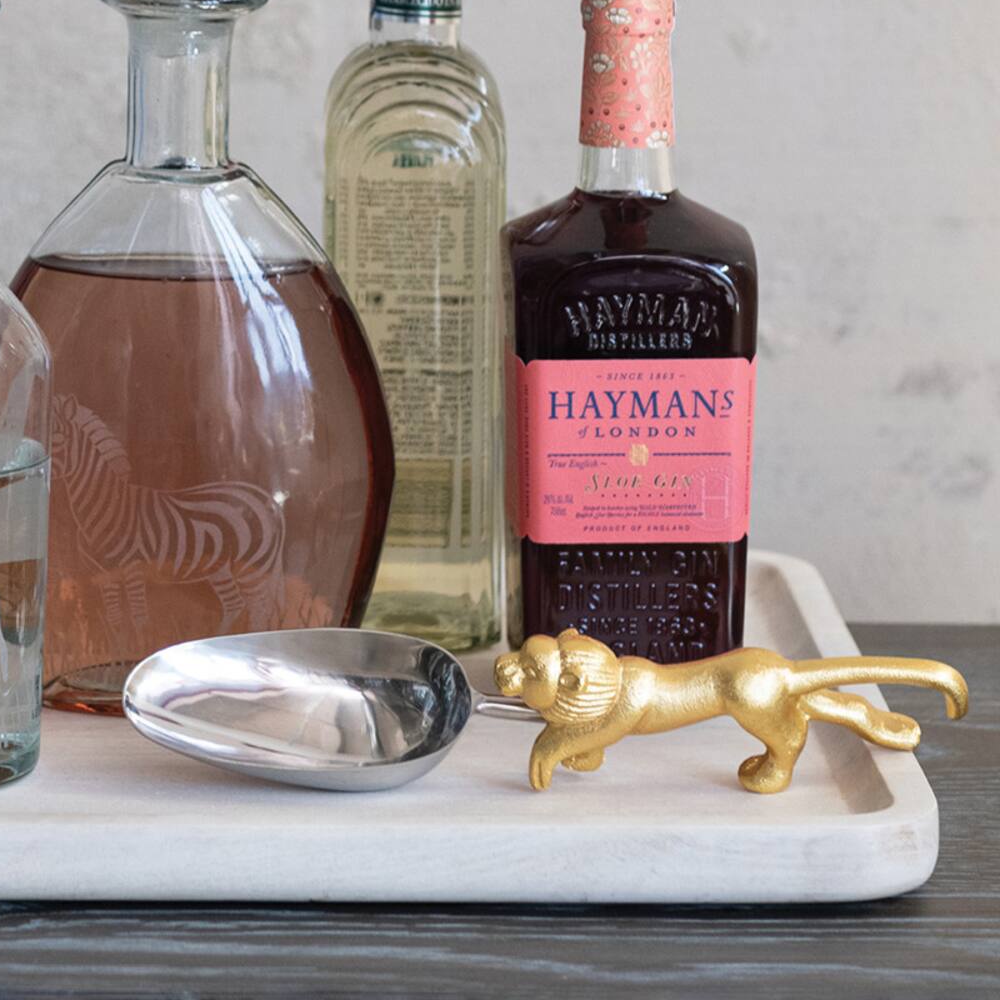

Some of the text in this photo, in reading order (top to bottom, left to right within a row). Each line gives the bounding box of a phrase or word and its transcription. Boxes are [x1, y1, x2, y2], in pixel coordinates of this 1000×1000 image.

[564, 292, 720, 338] HAYMAN
[588, 331, 693, 350] DISTILLERS
[606, 372, 643, 381] SINCE
[594, 426, 697, 438] LONDON
[549, 458, 599, 470] True English
[583, 523, 691, 532] PRODUCT OF ENGLAND
[558, 550, 718, 576] FAMILY GIN
[558, 583, 718, 611] DISTILLERS
